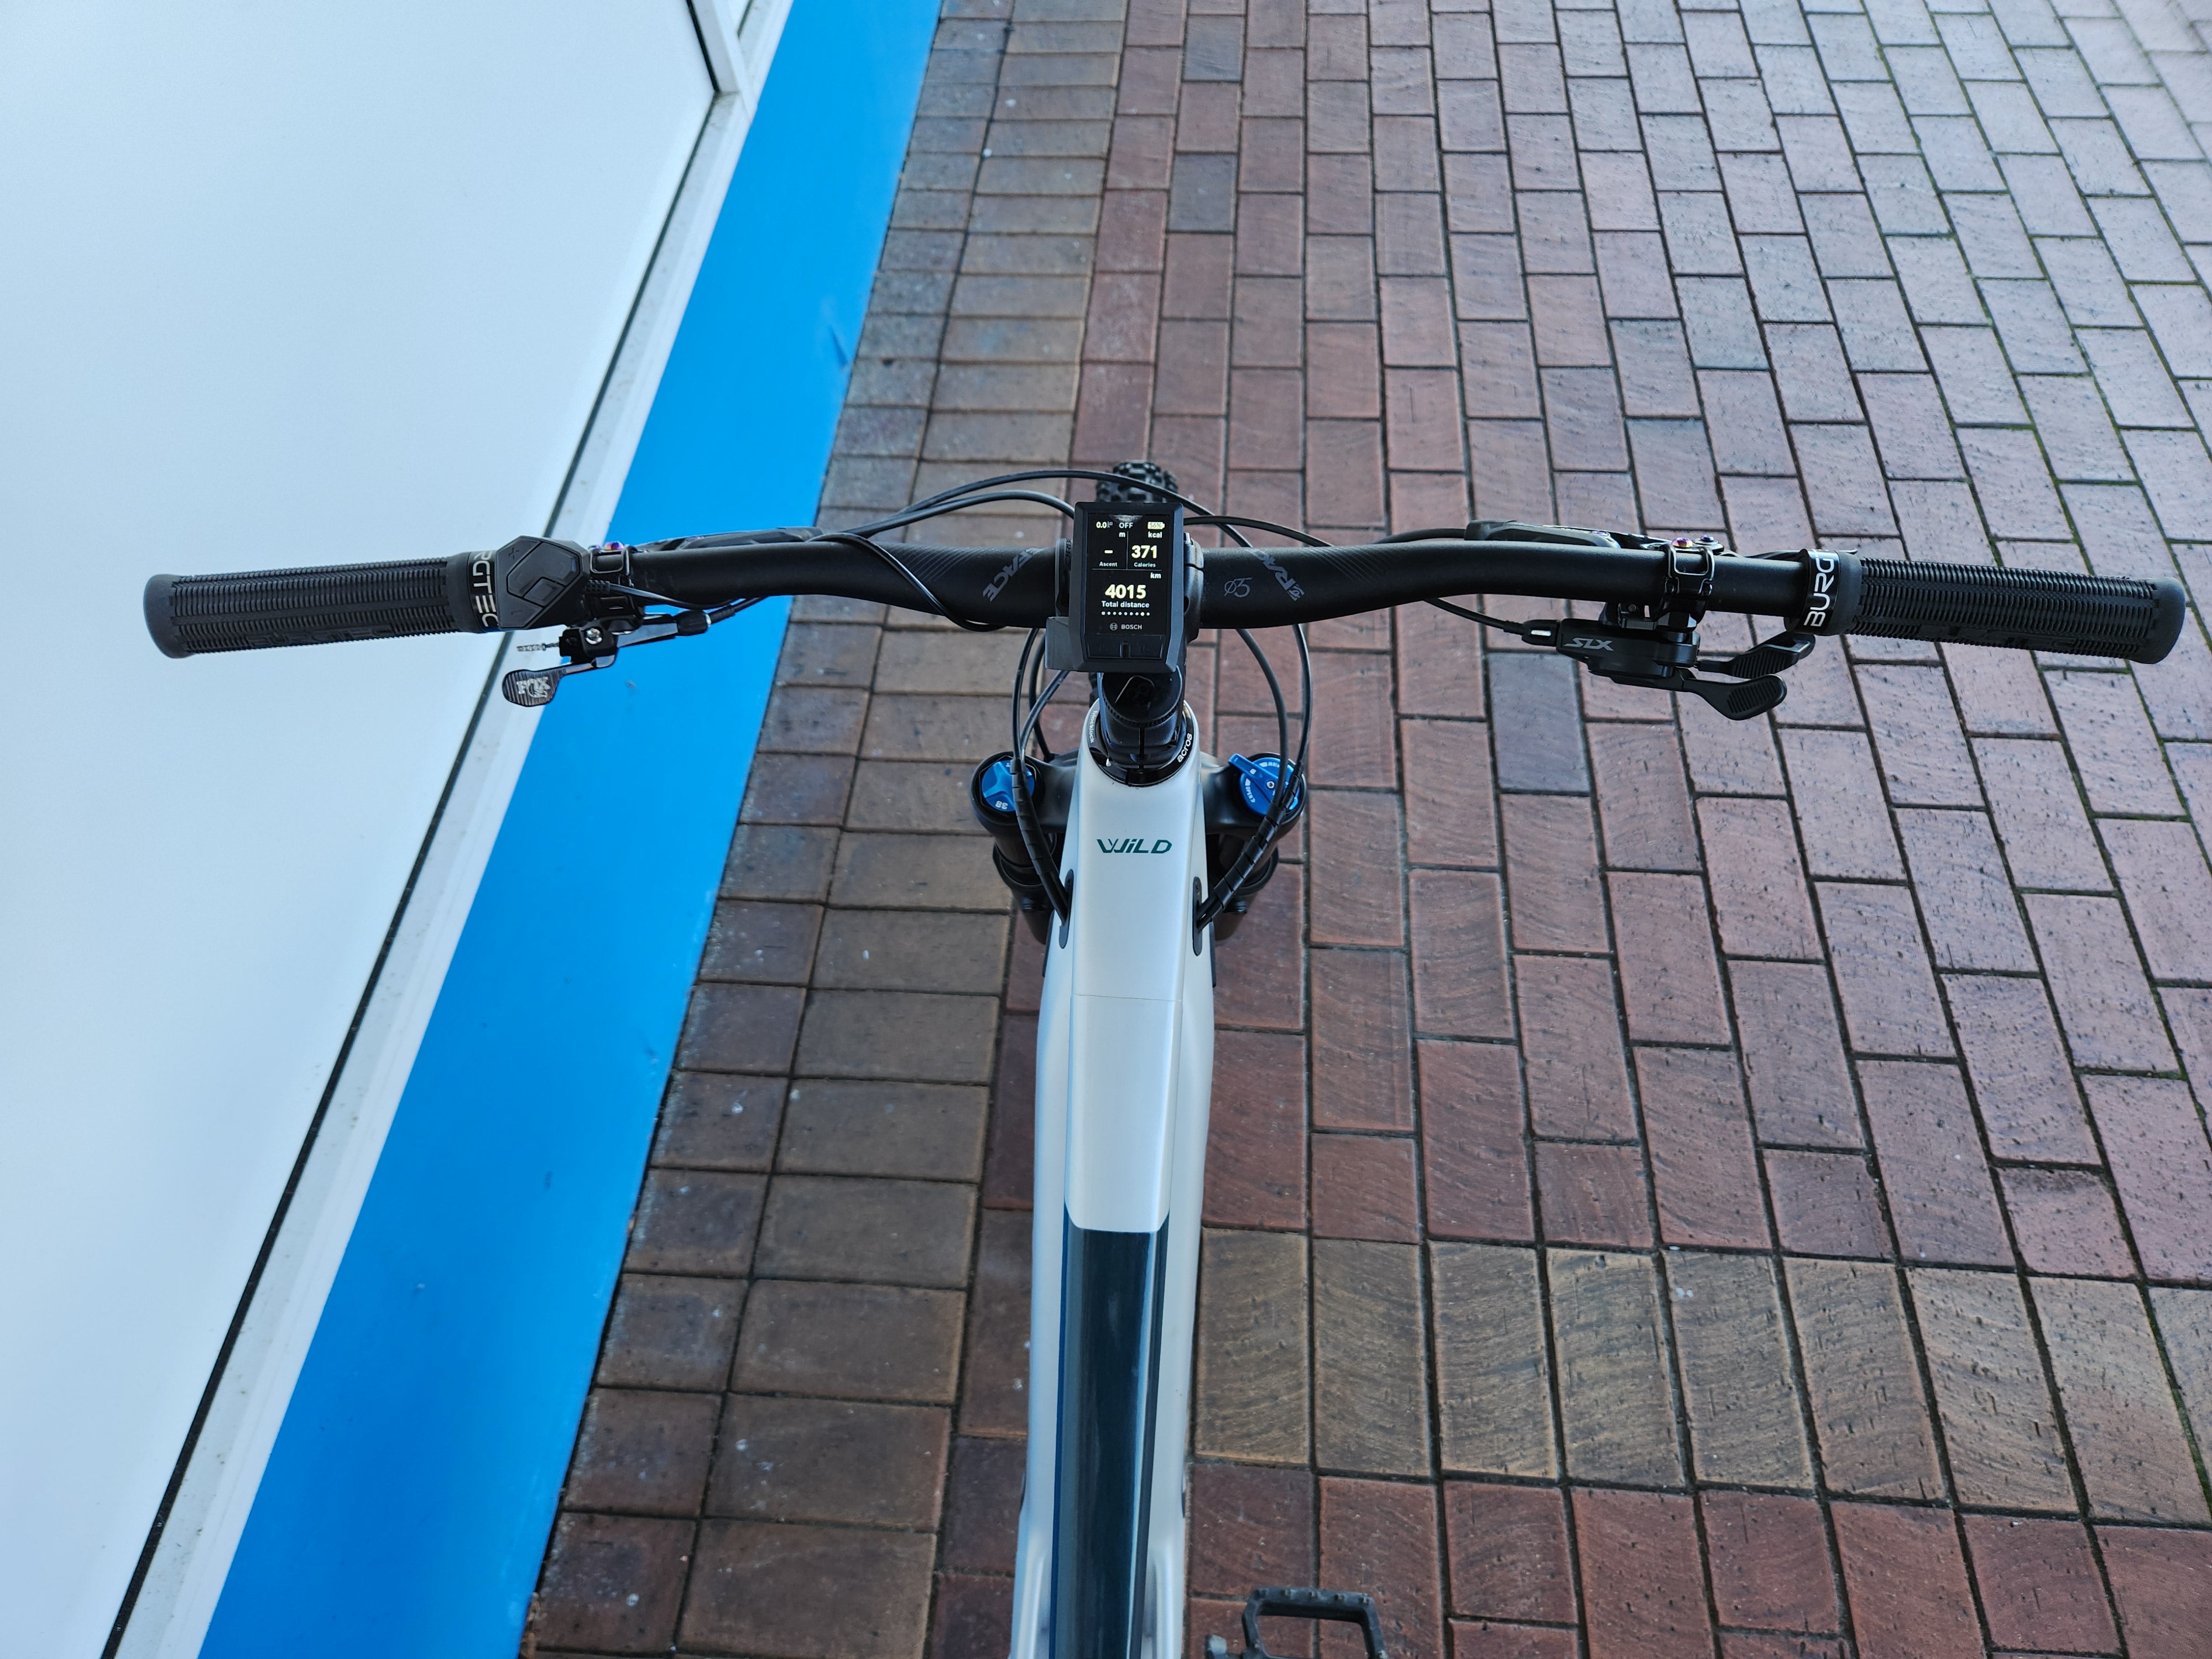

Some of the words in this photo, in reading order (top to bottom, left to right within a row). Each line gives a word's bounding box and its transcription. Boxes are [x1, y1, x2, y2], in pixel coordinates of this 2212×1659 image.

[1131, 545, 1157, 559] 371
[1105, 584, 1146, 599] 4015
[1563, 637, 1614, 651] SLX
[516, 676, 551, 698] FOX
[1089, 710, 1098, 743] blocklock
[1177, 732, 1192, 763] acros
[1245, 786, 1254, 799] OPEN
